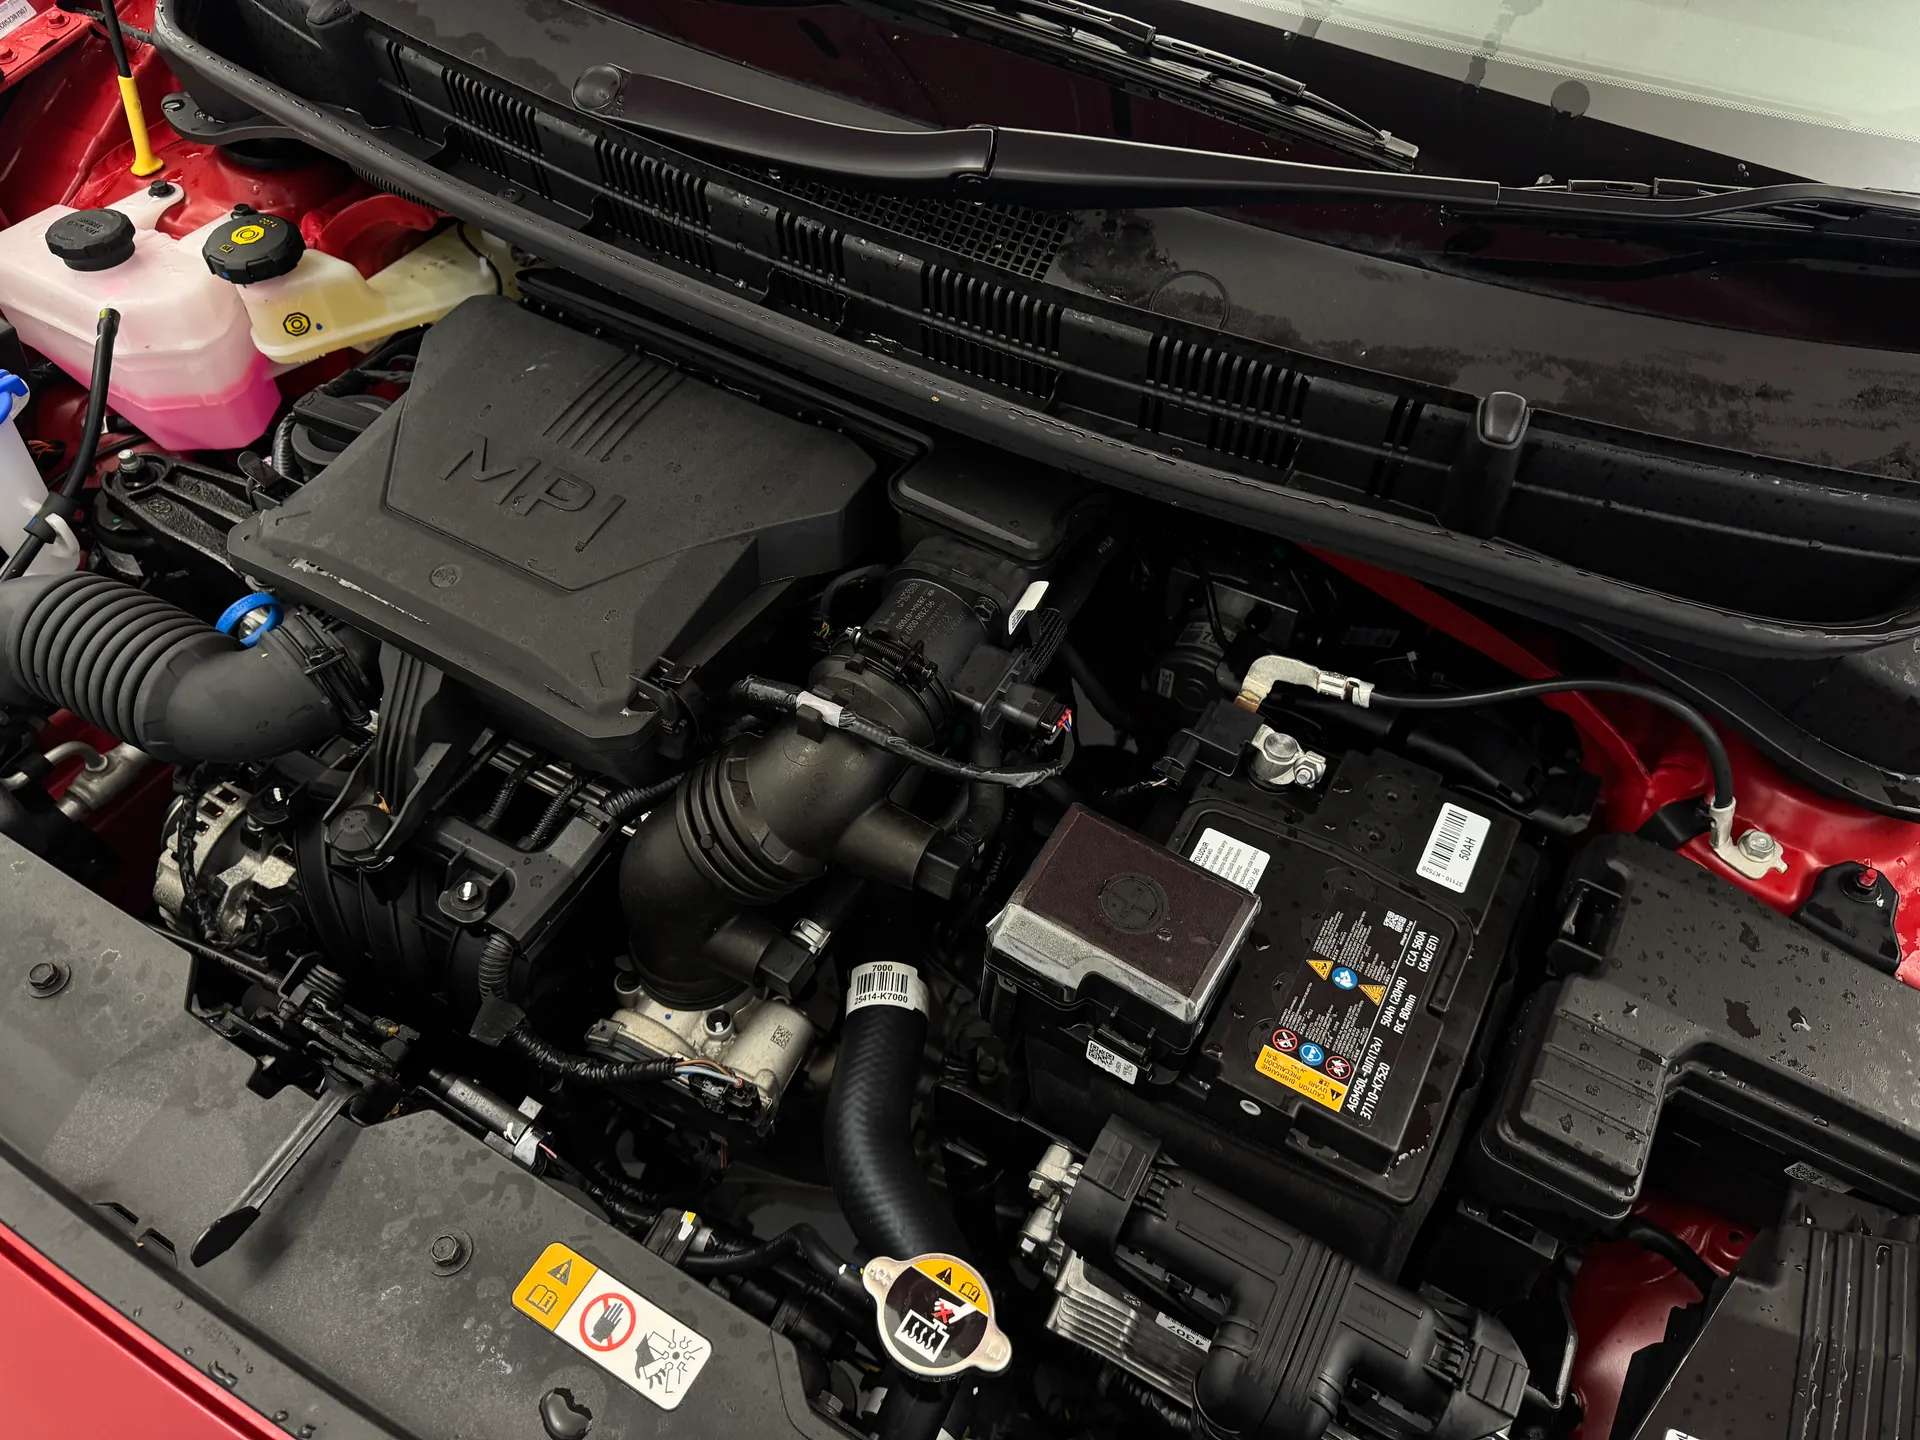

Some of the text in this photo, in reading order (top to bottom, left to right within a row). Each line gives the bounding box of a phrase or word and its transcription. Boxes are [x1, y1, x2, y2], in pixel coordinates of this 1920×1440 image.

[441, 432, 627, 553] MPI
[1458, 836, 1476, 861] 50AH
[1411, 930, 1428, 951] 560A
[872, 964, 893, 972] 7000
[1405, 950, 1420, 967] CCA
[854, 992, 908, 1005] 25414-K7000
[1380, 1005, 1397, 1028] 50Ah
[1389, 976, 1408, 1005] (20HR)
[1393, 994, 1417, 1035] RC 80min
[1298, 1083, 1326, 1100] CAUTION
[1360, 1061, 1391, 1121] 37110-K7520
[1167, 1325, 1205, 1347] 4307
